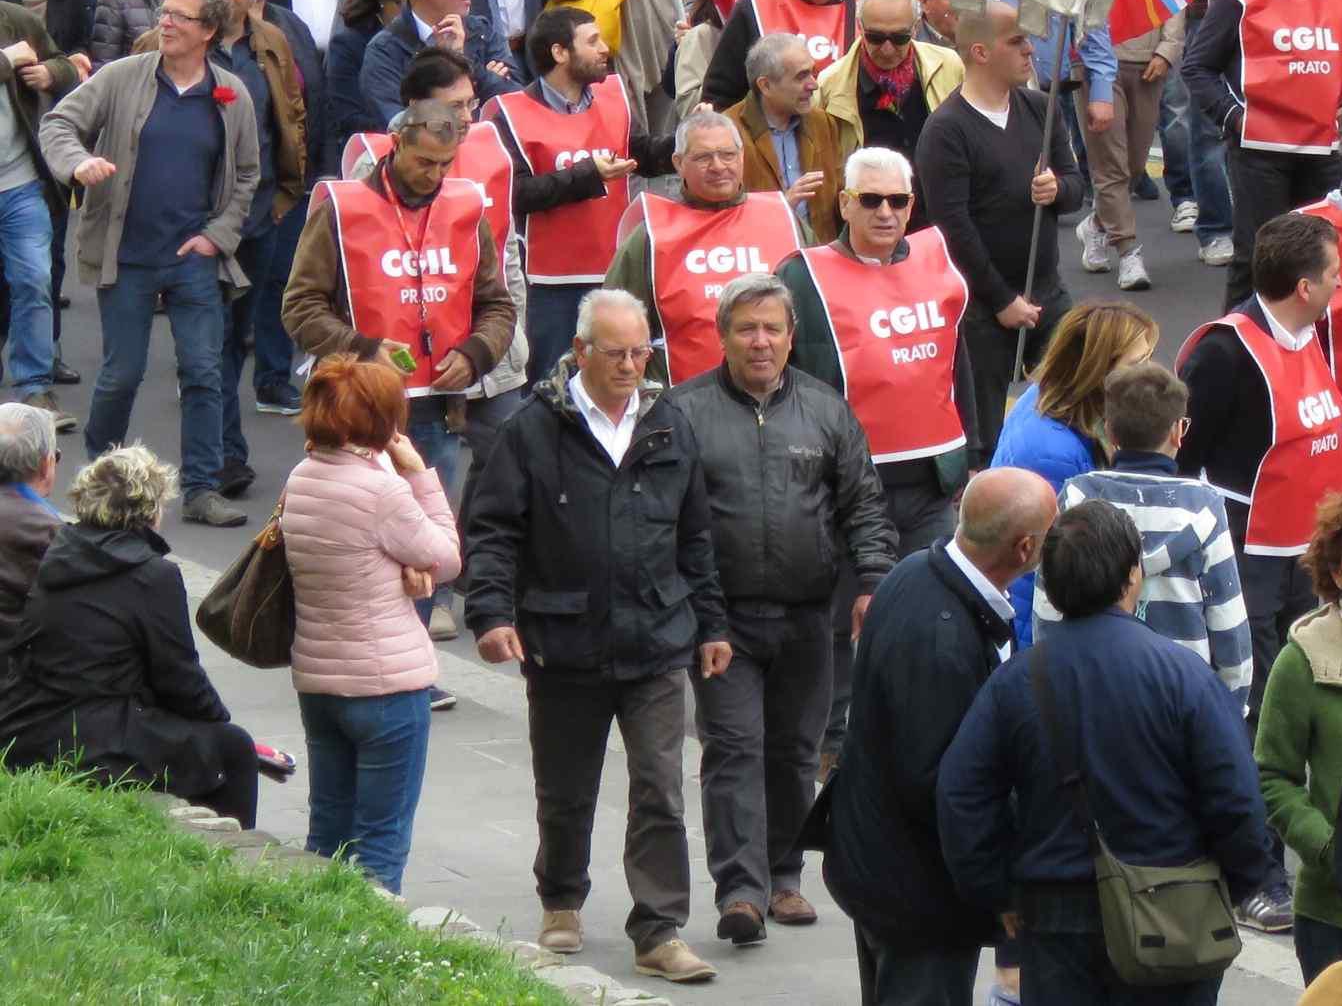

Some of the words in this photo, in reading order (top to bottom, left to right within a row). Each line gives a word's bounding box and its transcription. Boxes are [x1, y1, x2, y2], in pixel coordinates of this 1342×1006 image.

[1273, 26, 1340, 51] CGIL
[1288, 60, 1331, 75] PRATO
[381, 245, 458, 278] CGIL
[685, 246, 769, 275] CGIL
[400, 287, 447, 304] PRATO
[868, 300, 946, 339] CGIL
[890, 342, 938, 365] PRATO
[1297, 389, 1341, 430] CGIL
[1310, 433, 1339, 456] PRATO
